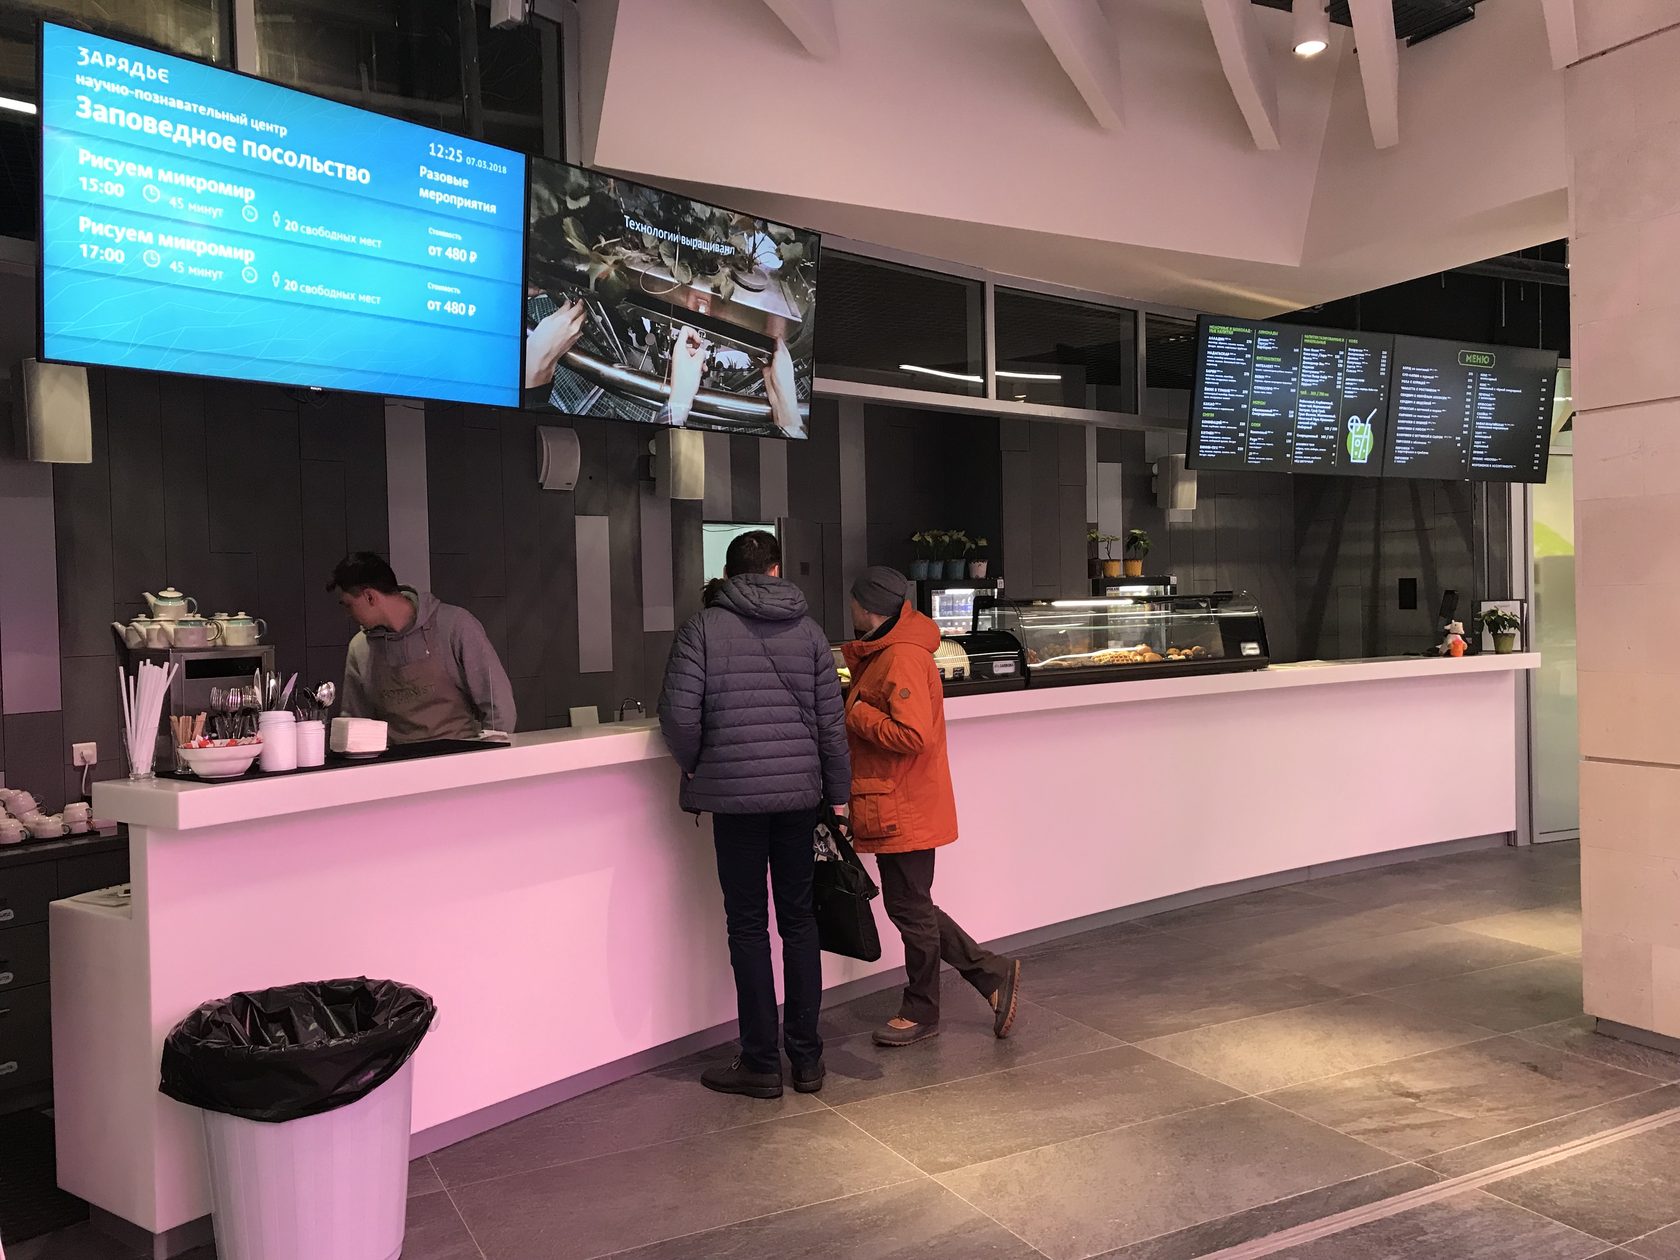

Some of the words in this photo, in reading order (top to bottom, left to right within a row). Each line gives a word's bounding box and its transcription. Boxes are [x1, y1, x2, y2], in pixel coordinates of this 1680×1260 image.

[76, 74, 248, 126] научно-познавательный
[251, 118, 288, 139] центр
[76, 95, 237, 153] Заповедное
[242, 139, 371, 185] посольство
[428, 142, 463, 163] 12:25
[466, 156, 507, 174] 07.03.2018
[78, 148, 153, 177] Рисуем
[157, 169, 256, 203] микромир
[419, 165, 469, 188] Разовые
[78, 177, 125, 197] 15:00
[169, 197, 185, 209] 45
[188, 202, 224, 219] минут
[284, 219, 299, 232] 20
[300, 225, 356, 243] свободных
[419, 188, 497, 214] мероприятия
[78, 216, 154, 244] Рисуем
[158, 234, 255, 265] микромир
[624, 215, 679, 243] Технологии
[428, 245, 443, 257] от
[444, 246, 468, 262] 480
[79, 244, 125, 264] 17:00
[169, 260, 185, 273] 45
[188, 265, 224, 282] минут
[283, 279, 299, 292] 20
[299, 284, 356, 301] свободных
[427, 300, 442, 311] от
[443, 301, 467, 316] 480
[1465, 354, 1490, 365] МЕНЮ
